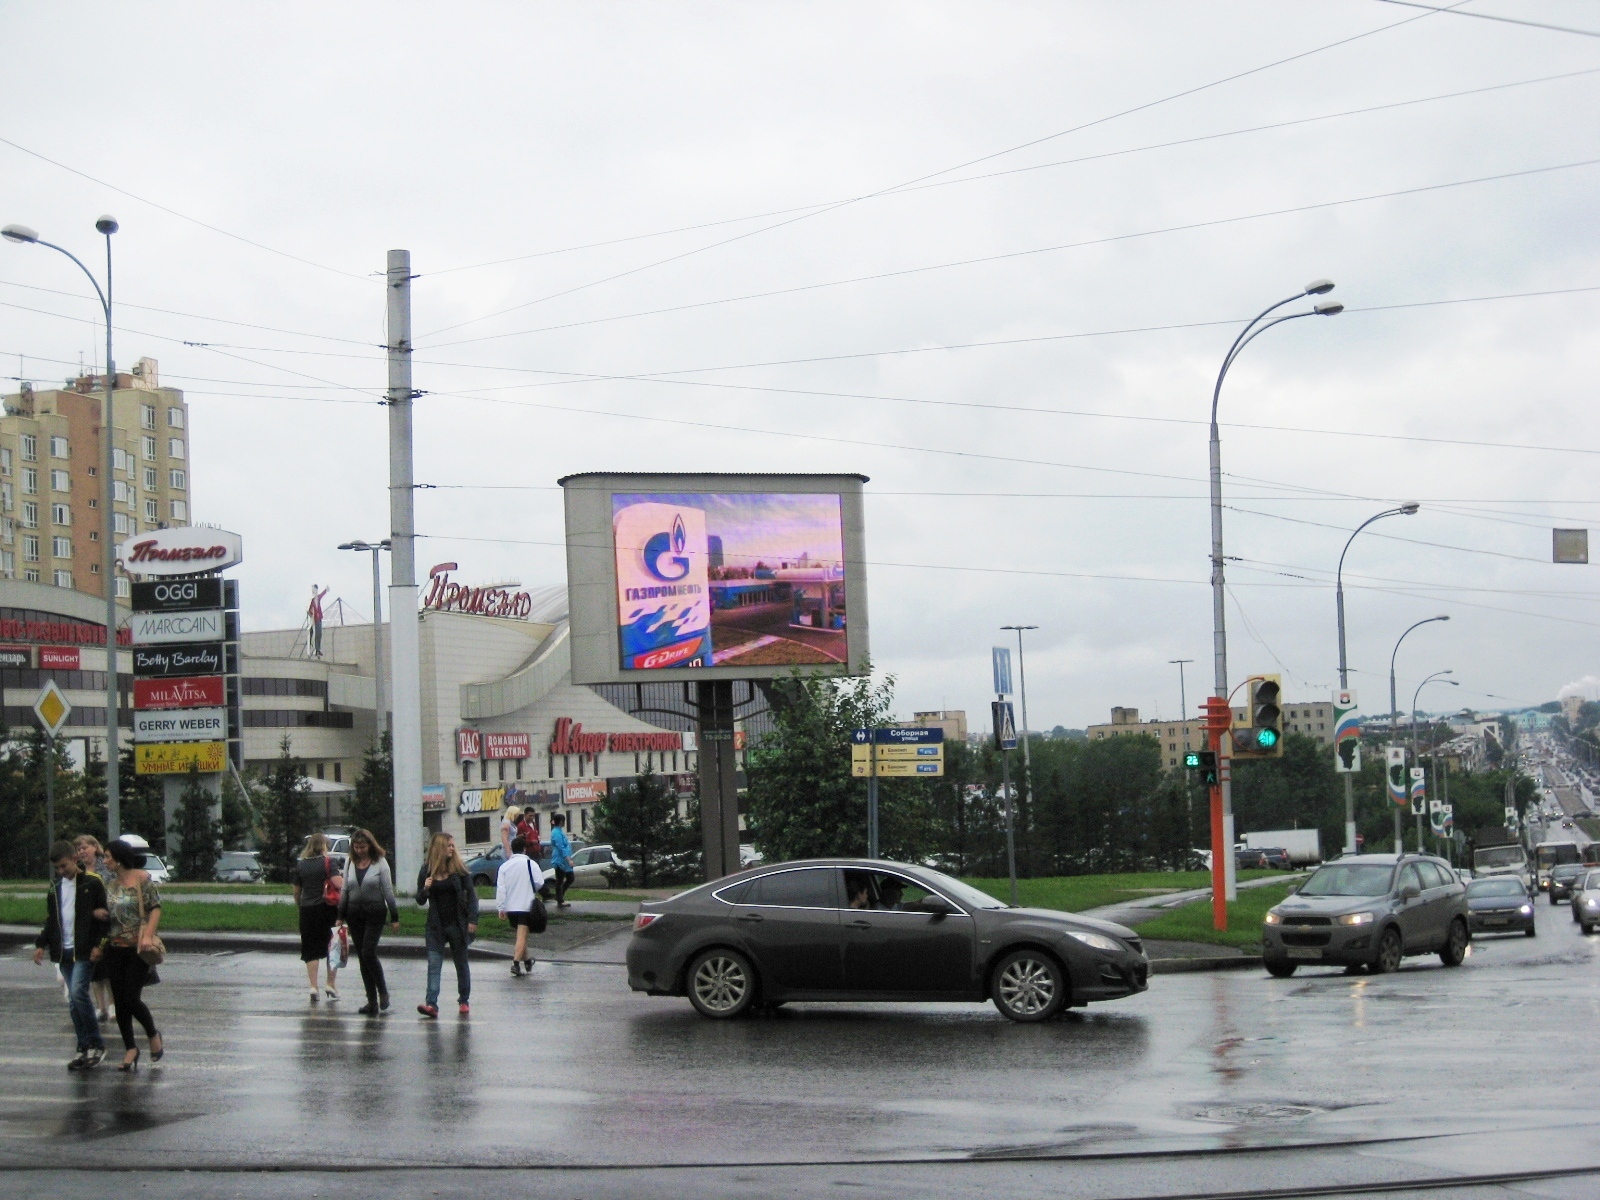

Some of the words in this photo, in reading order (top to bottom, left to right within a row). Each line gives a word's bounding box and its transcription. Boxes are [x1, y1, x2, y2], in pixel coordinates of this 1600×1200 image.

[155, 583, 198, 601] OGGI
[43, 654, 79, 662] SUNLIGHT
[136, 653, 169, 673] Betty
[172, 650, 218, 671] Barclay
[139, 720, 176, 731] GERRY
[179, 718, 220, 730] WEBER
[488, 733, 528, 745] ДОМАШНИЙ
[890, 729, 929, 737] Соборная
[610, 732, 683, 751] ЭЛЕКТРОНИКА
[491, 747, 526, 757] ТЕКСТИЛЬ
[142, 761, 176, 772] УМНЫЕ
[566, 786, 593, 799] LORENA
[459, 787, 505, 814] SUBWAY
